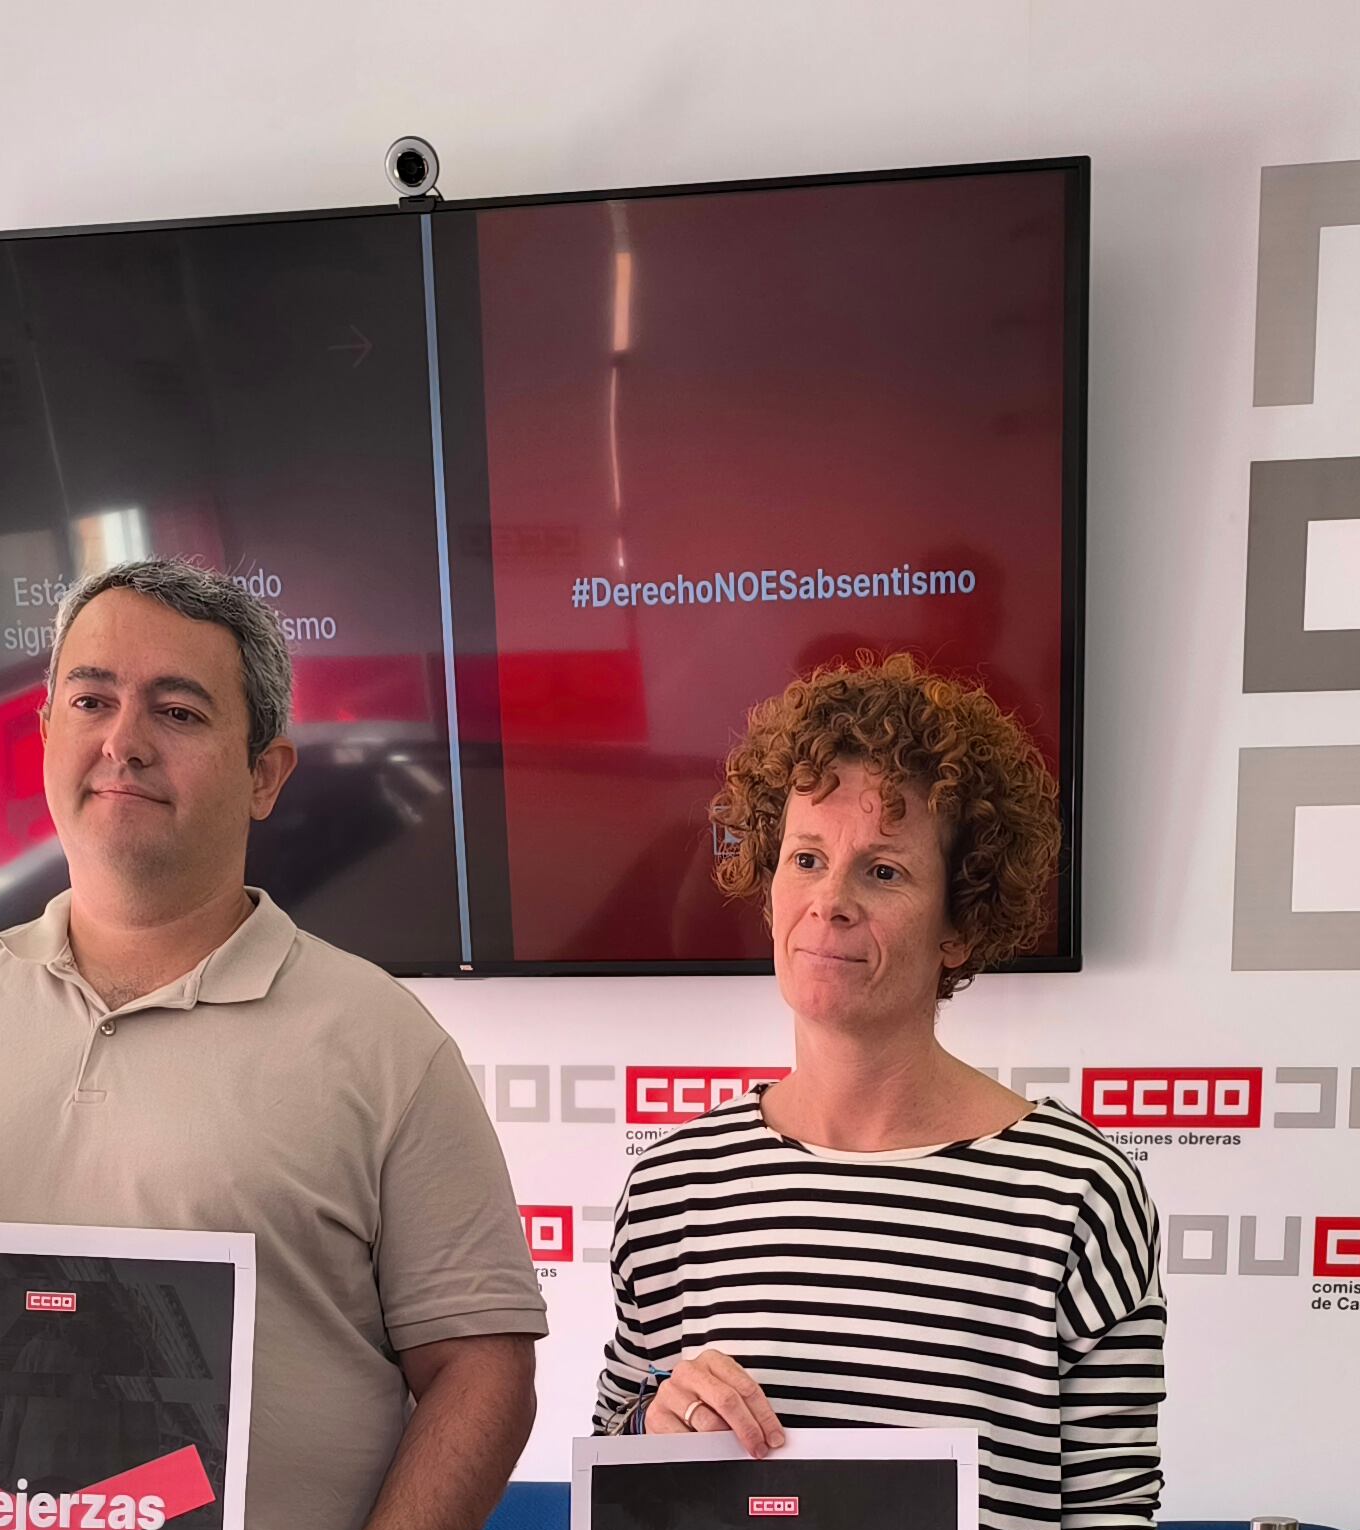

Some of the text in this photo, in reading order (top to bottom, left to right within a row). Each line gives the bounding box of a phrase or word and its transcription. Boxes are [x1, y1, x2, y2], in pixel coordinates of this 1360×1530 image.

[13, 574, 74, 607] Está
[572, 564, 976, 608] #DerechoNOESabsentismo
[1178, 1132, 1241, 1145] obreras
[1311, 1297, 1331, 1310] de
